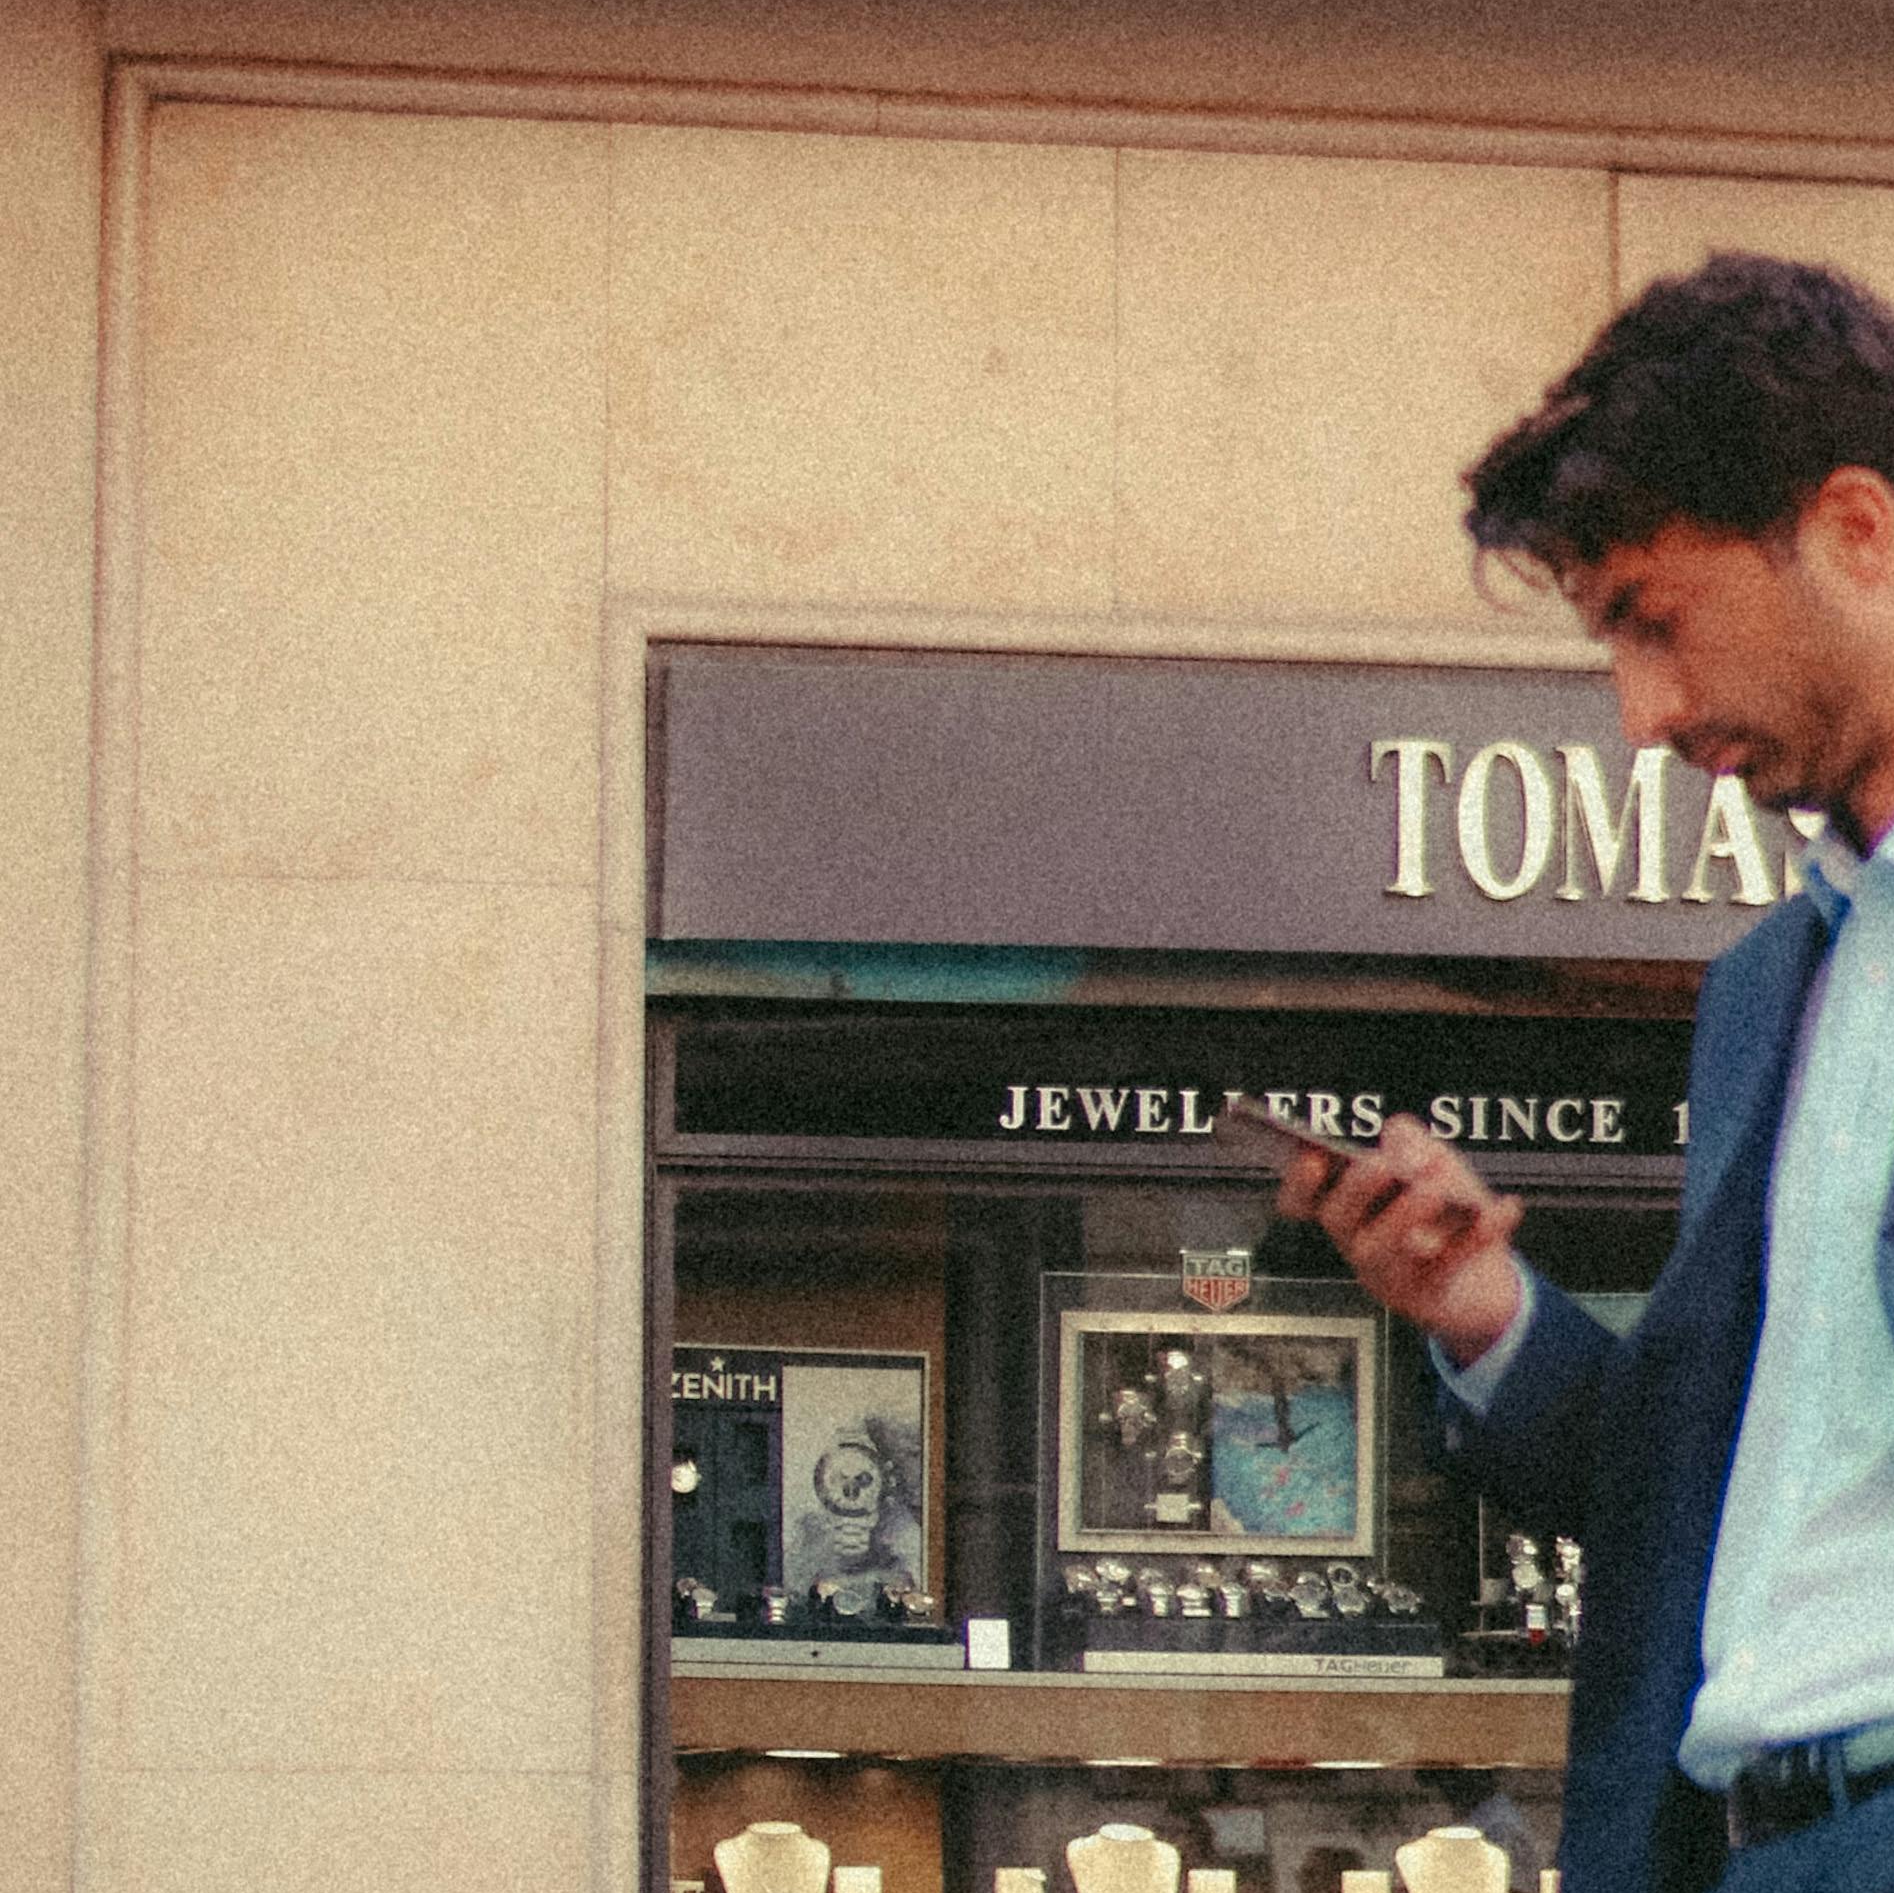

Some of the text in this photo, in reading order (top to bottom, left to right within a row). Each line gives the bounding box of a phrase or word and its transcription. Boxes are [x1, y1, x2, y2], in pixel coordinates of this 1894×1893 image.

[1000, 1086, 1383, 1138] JEWELERS
[1429, 1095, 1626, 1144] SINCE
[1188, 1258, 1244, 1276] TAG
[1186, 1278, 1246, 1305] HEUER
